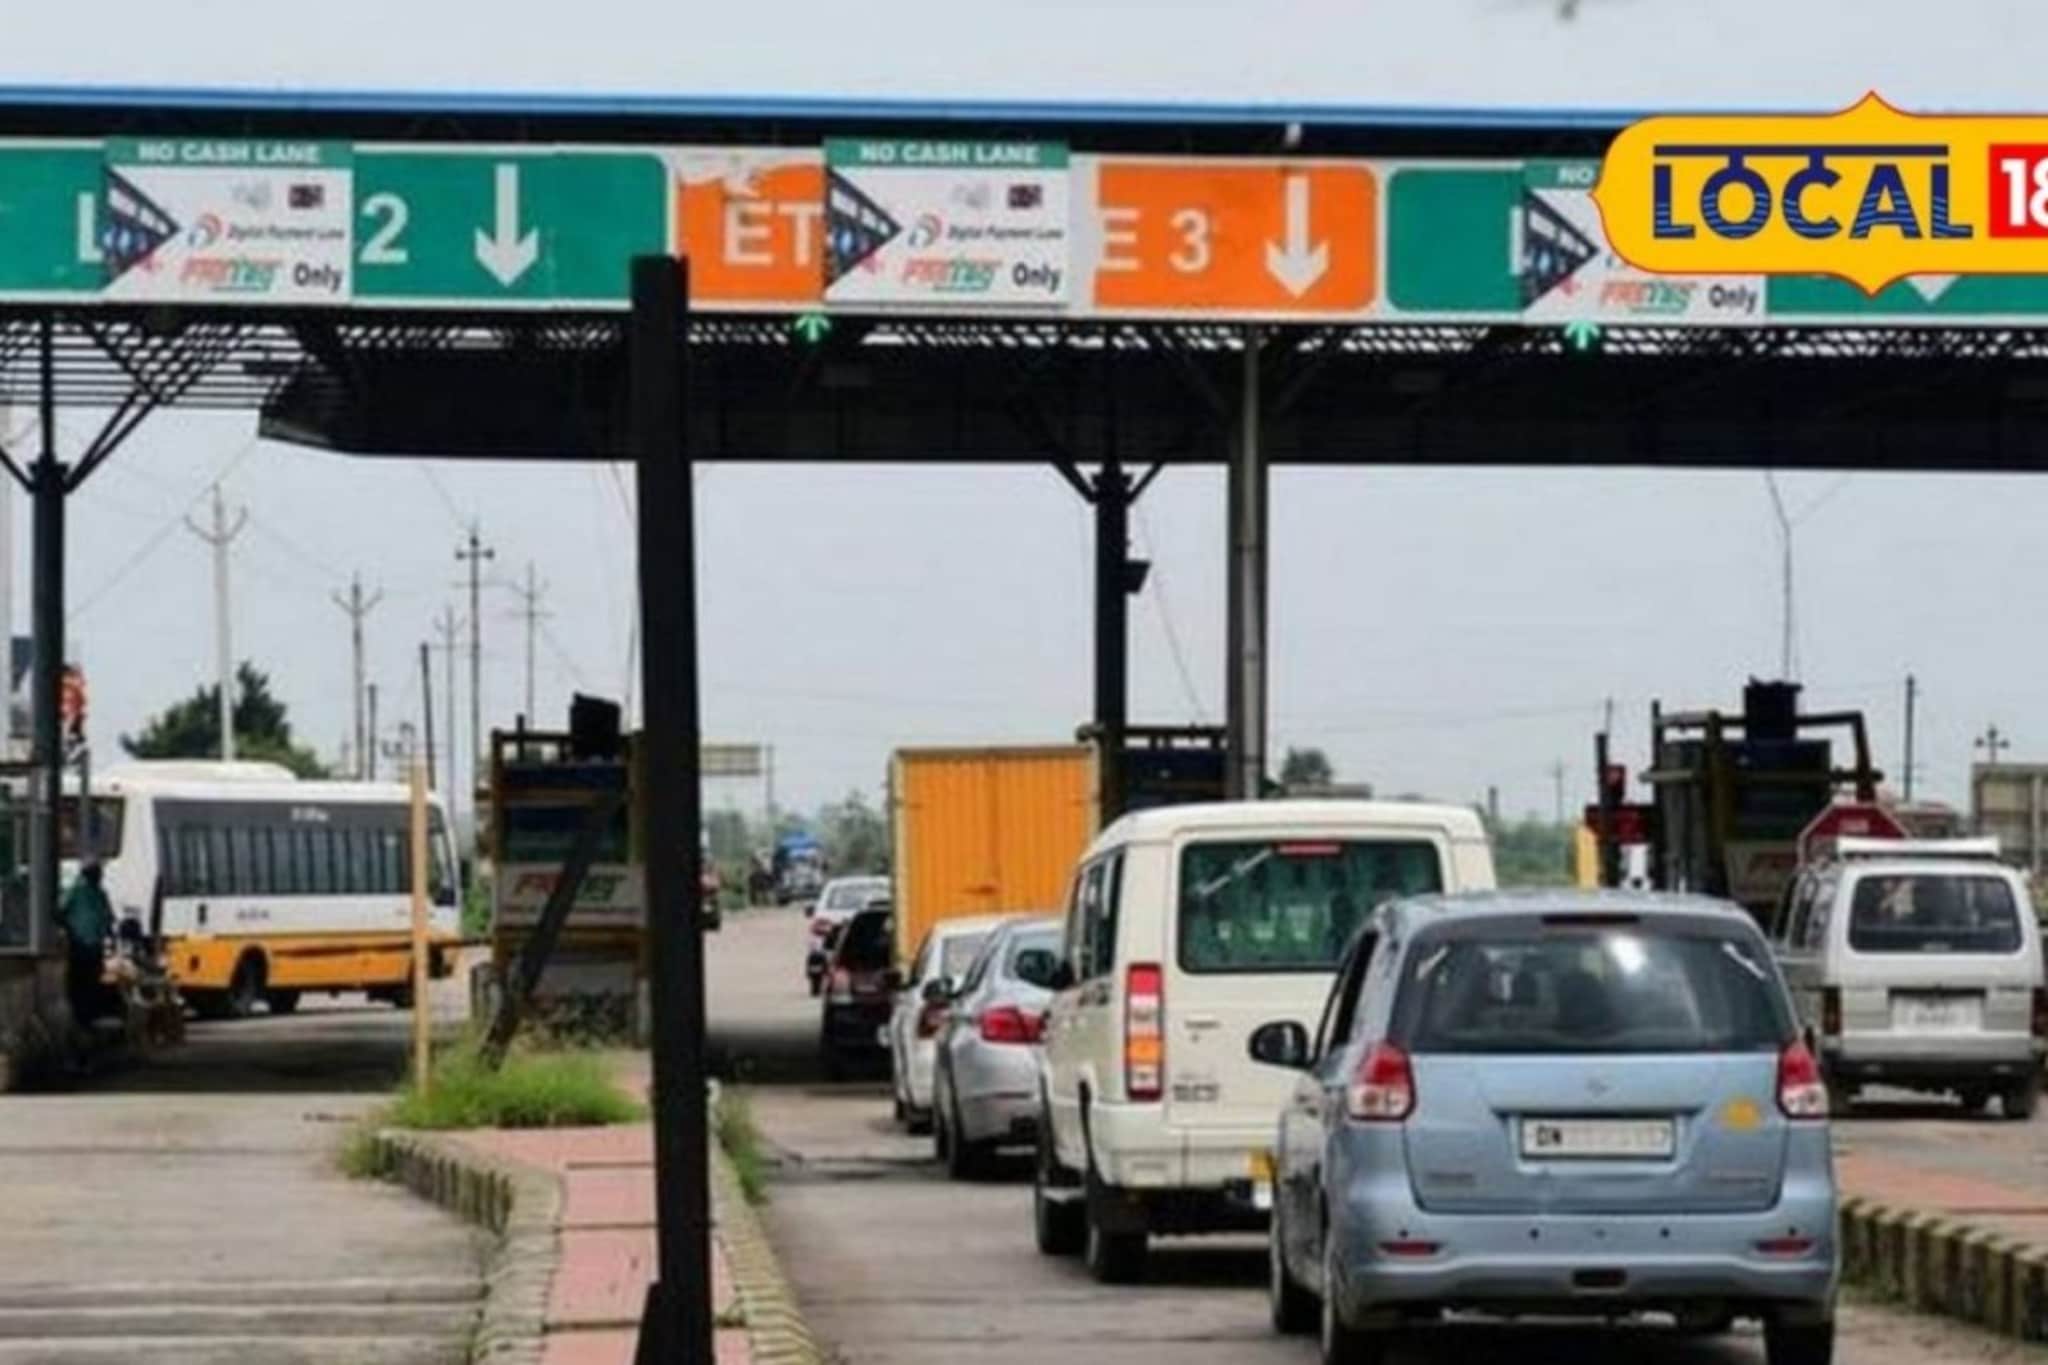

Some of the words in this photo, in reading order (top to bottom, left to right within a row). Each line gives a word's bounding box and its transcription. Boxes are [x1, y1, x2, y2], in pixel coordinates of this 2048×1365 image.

[138, 143, 175, 161] NO
[182, 143, 248, 161] CASH
[254, 145, 321, 162] LANE
[859, 143, 893, 161] NO
[901, 143, 970, 162] CASH
[976, 145, 1040, 163] LANE
[1557, 166, 1595, 183] NO
[360, 193, 409, 264] 2
[1169, 208, 1211, 274] 3
[293, 261, 343, 293] Only
[1012, 261, 1060, 293] Only
[1708, 284, 1758, 313] Only
